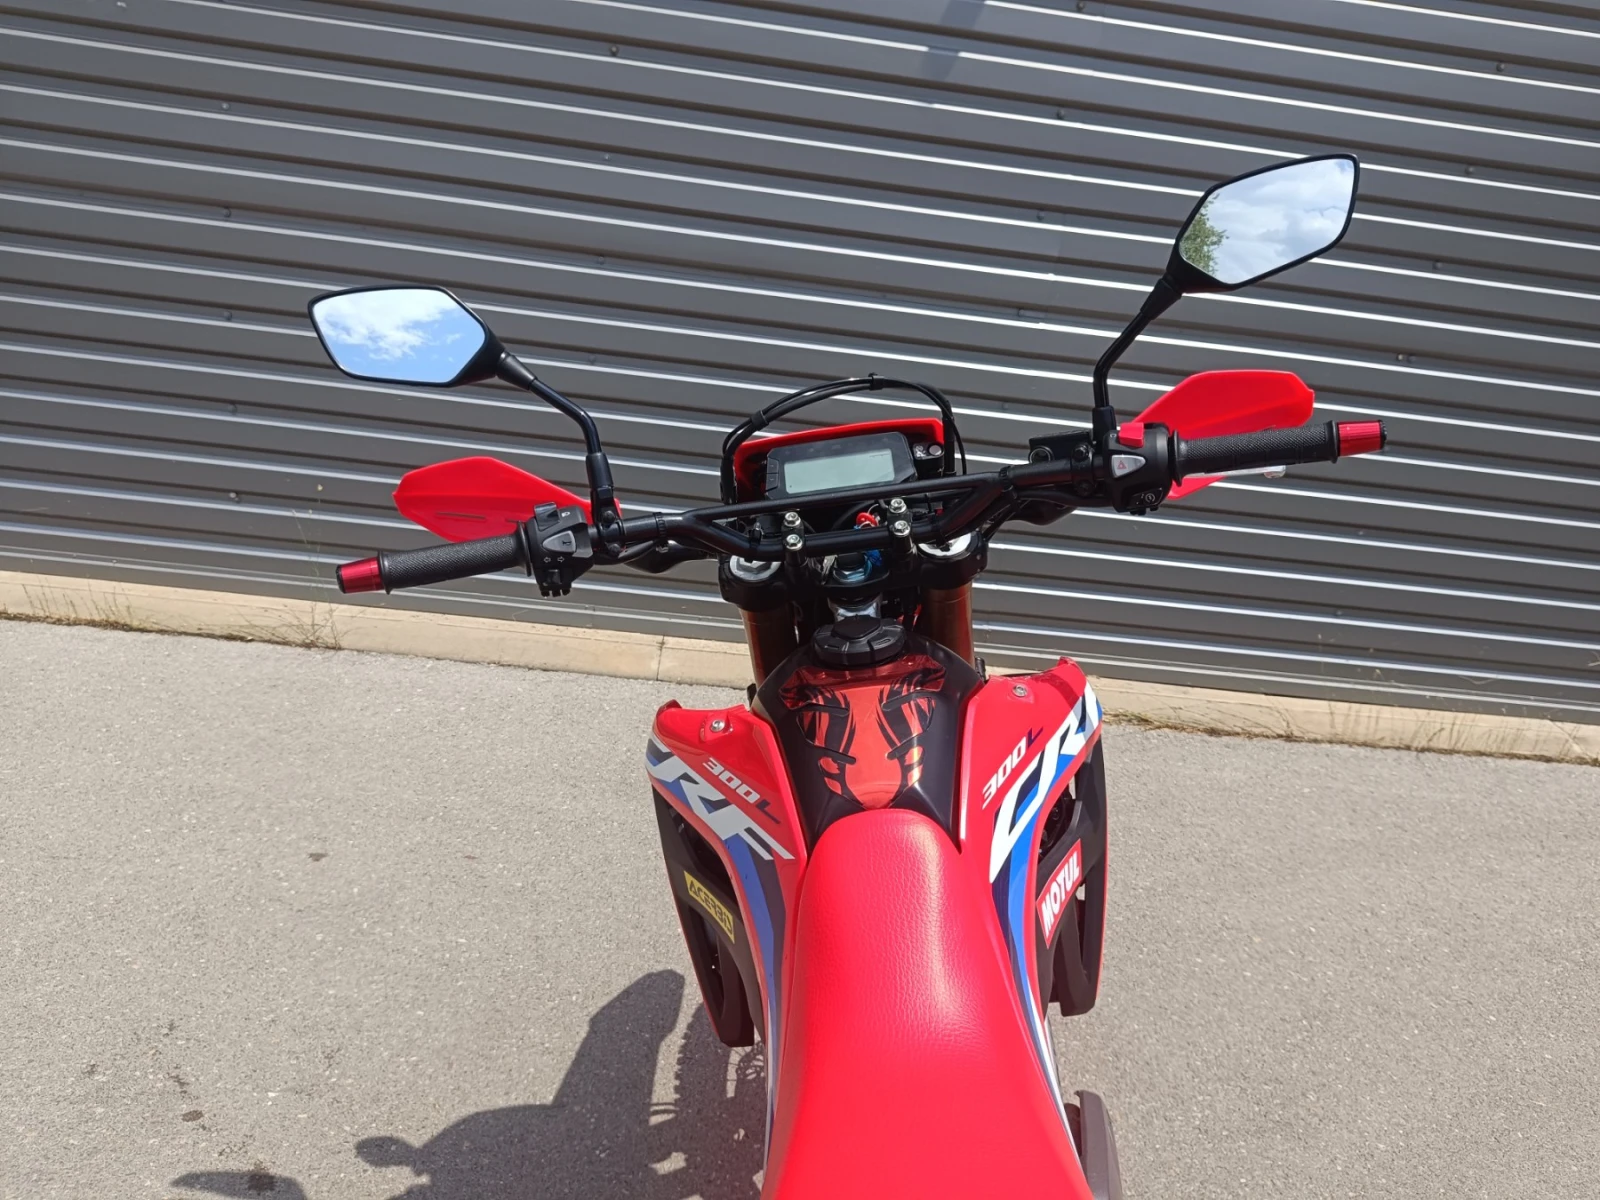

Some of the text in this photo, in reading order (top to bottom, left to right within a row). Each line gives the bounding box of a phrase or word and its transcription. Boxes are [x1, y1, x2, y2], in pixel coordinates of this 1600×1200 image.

[702, 757, 782, 824] 300L
[982, 726, 1044, 811] 300L
[1041, 851, 1080, 938] MOTUL
